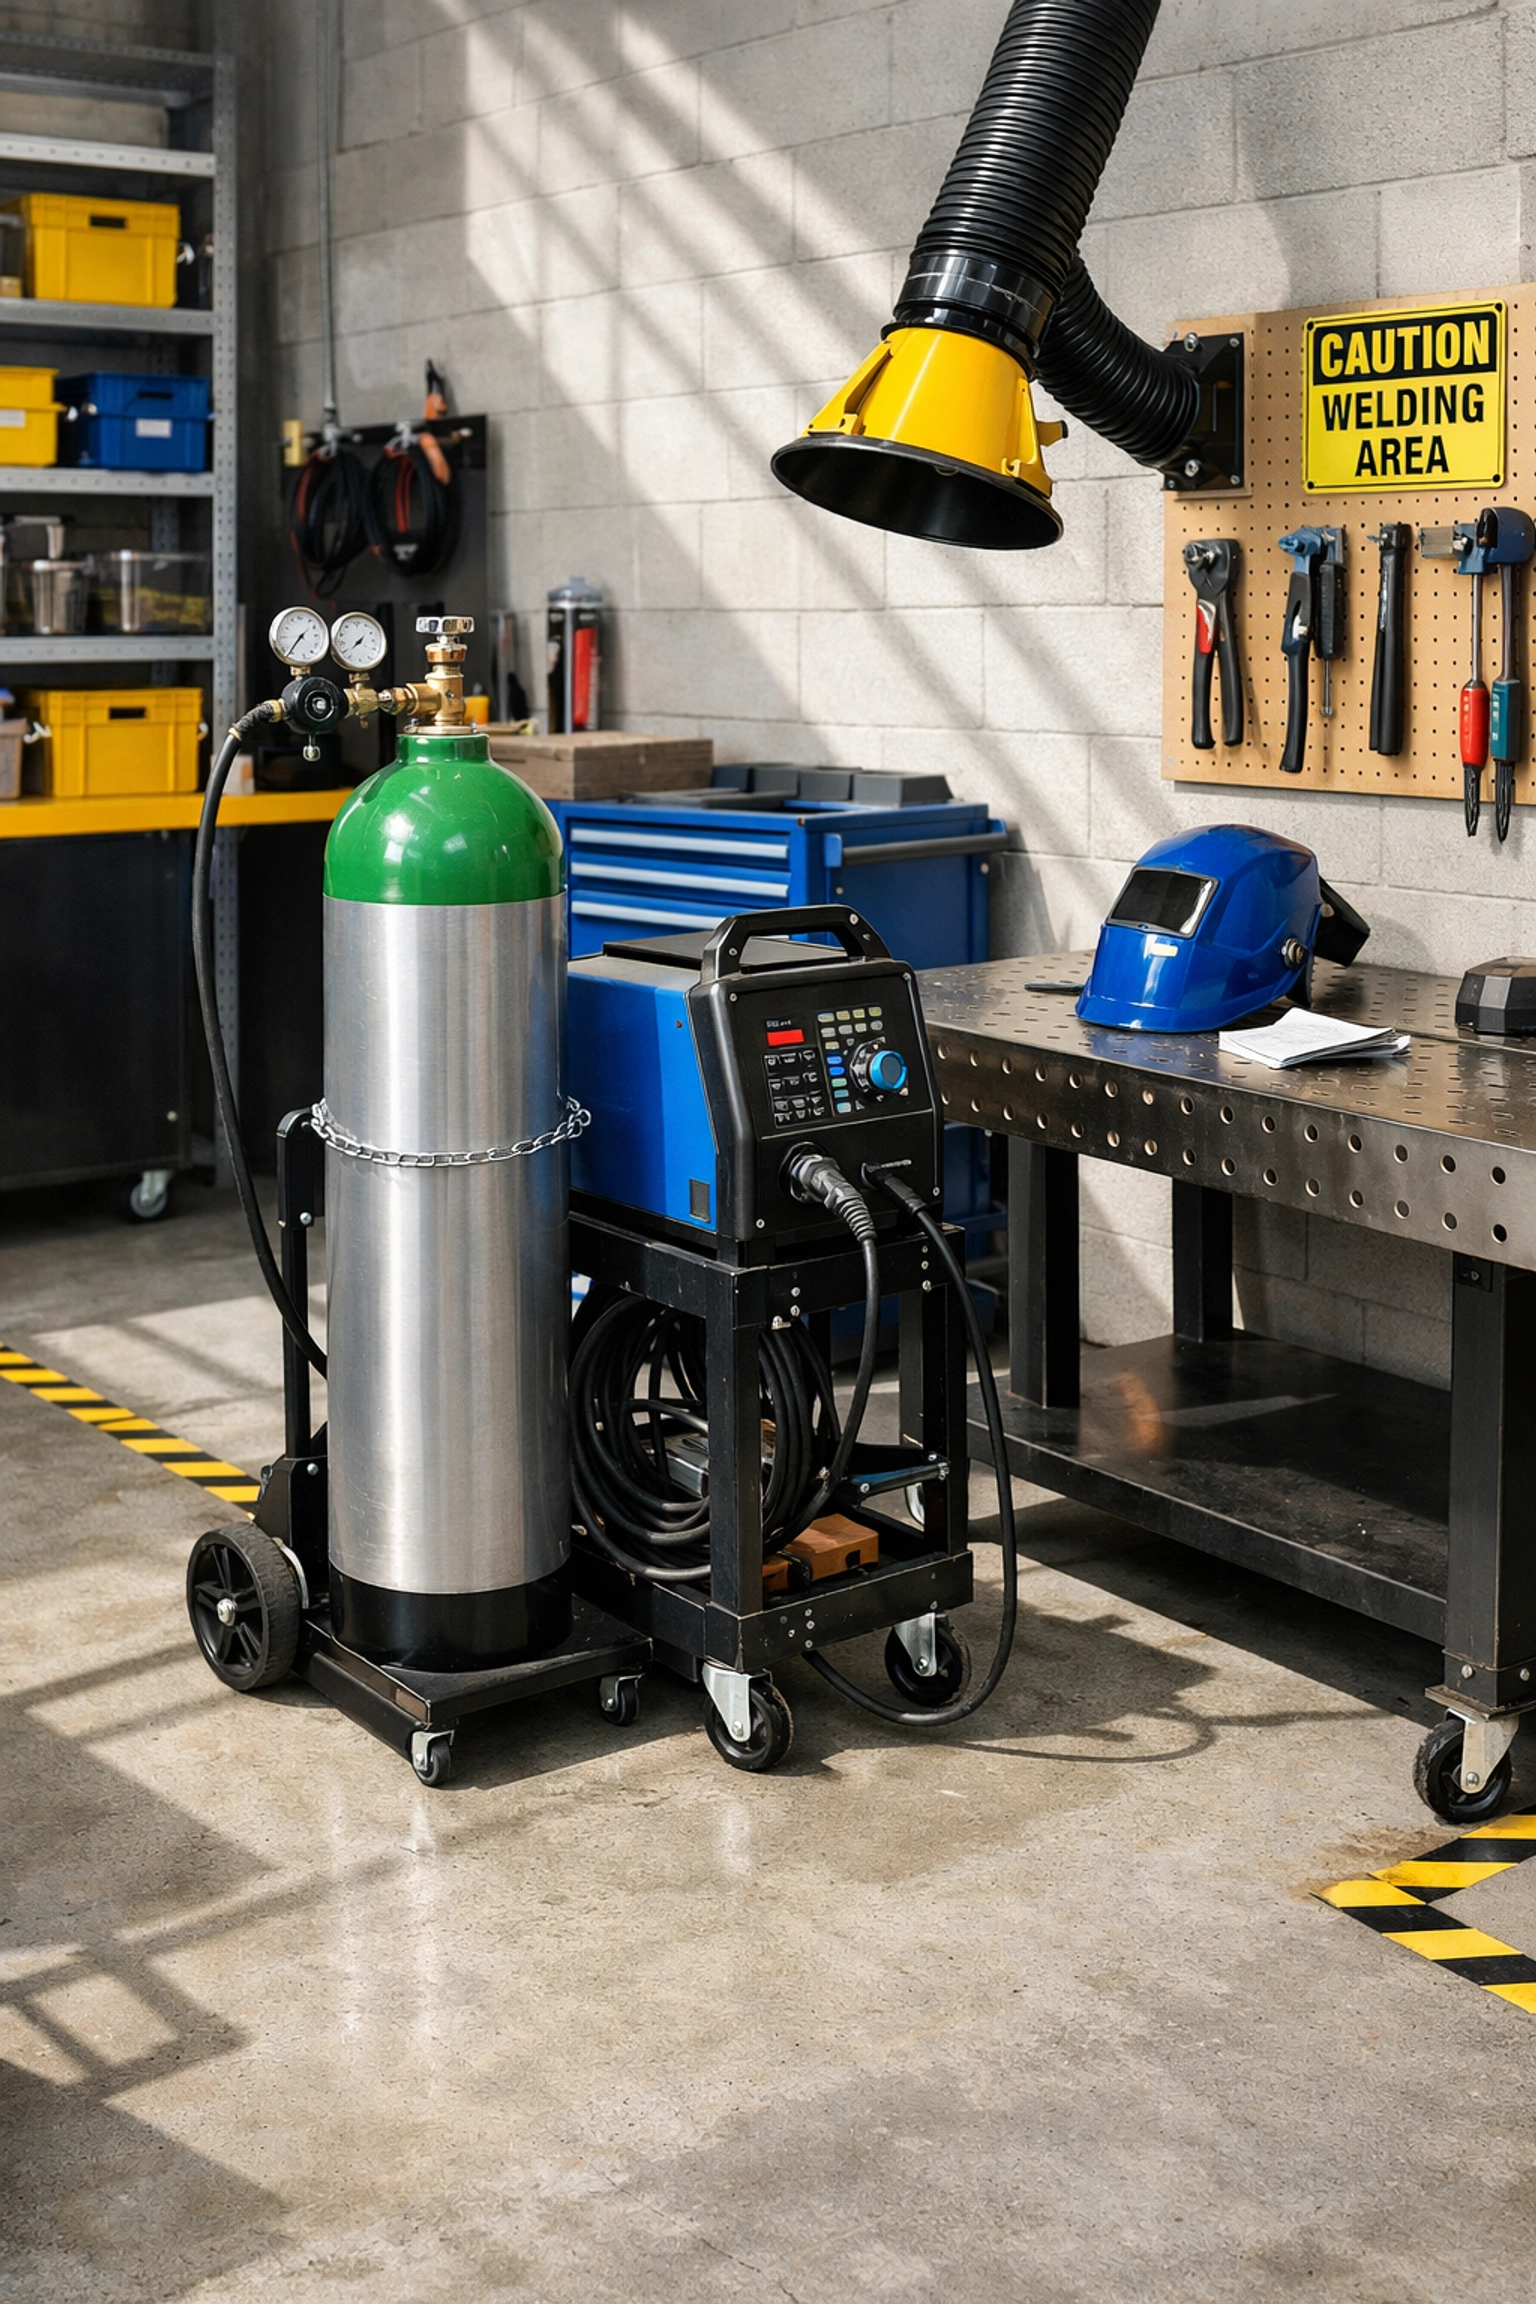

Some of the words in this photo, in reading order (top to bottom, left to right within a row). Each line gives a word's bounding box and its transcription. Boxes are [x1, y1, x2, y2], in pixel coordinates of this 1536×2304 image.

[1320, 320, 1490, 378] CAUTION
[1322, 383, 1484, 431] WELDING
[1355, 435, 1449, 477] AREA
